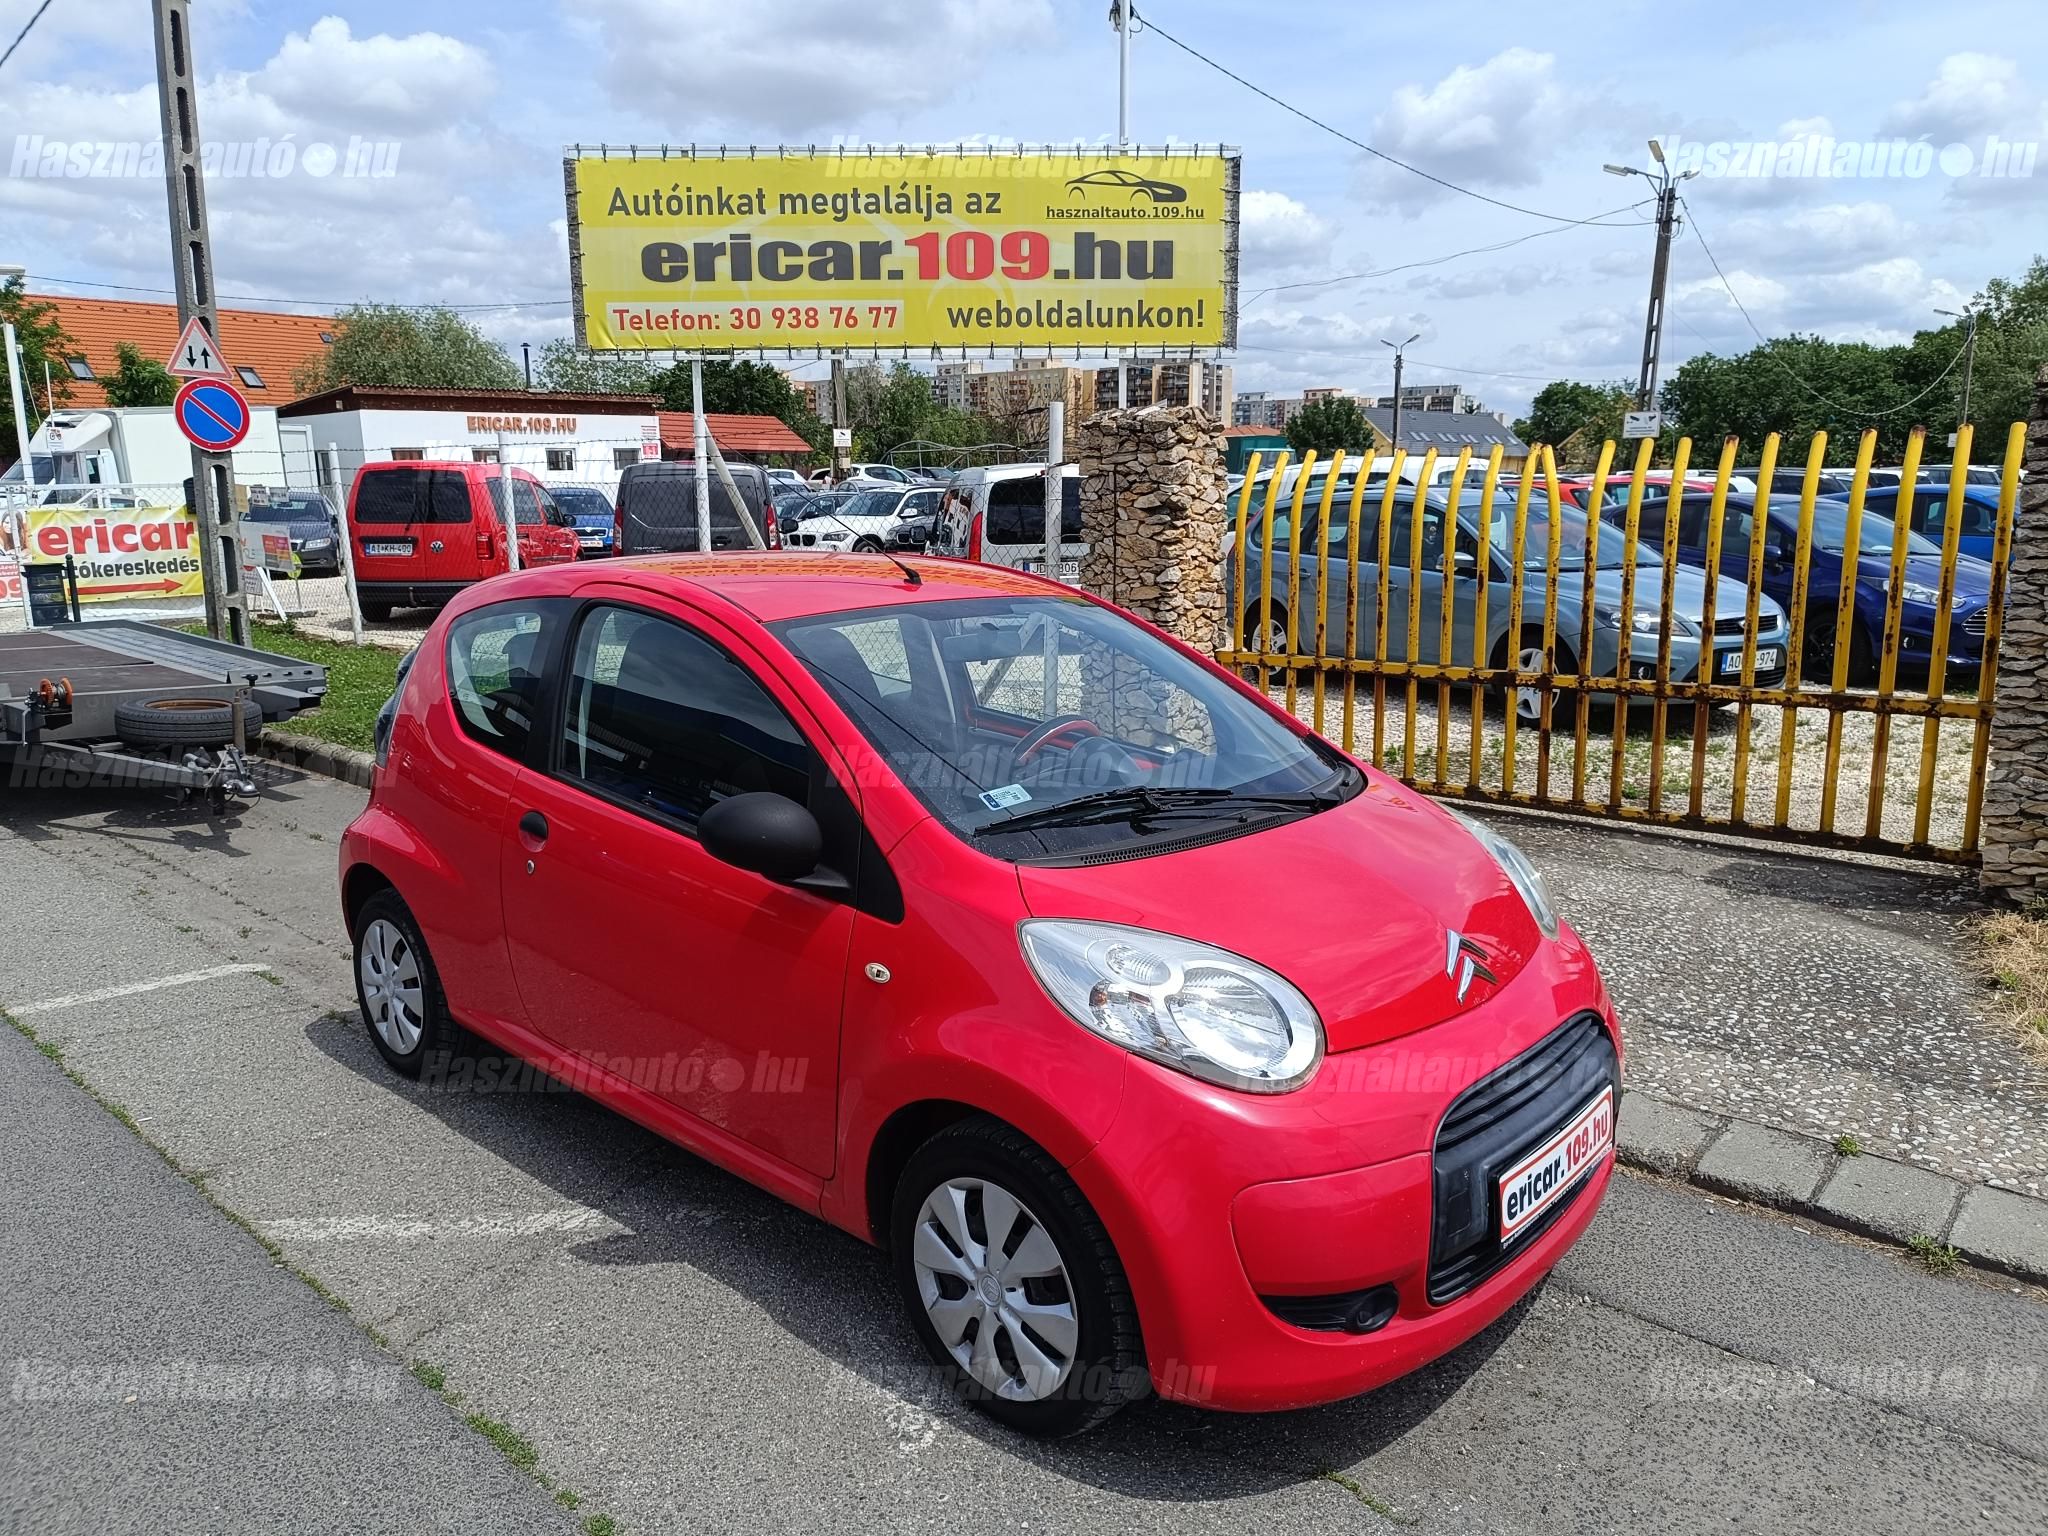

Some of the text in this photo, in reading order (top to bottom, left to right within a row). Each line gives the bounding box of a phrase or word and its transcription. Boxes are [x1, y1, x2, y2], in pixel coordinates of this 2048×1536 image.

[607, 181, 1002, 222] Autóinkat megtalálja az
[1046, 205, 1205, 219] hasznaltauto.109.hu
[641, 231, 1174, 283] ericar.109.hu
[612, 306, 897, 331] Telefon: 30 938 76 77
[947, 299, 1204, 329] weboldalunkon!
[467, 415, 577, 436] ERICAR.109.HU
[37, 518, 195, 557] ericar
[63, 556, 200, 583] tókereskedés
[1507, 1110, 1608, 1221] ericar.109.hu
